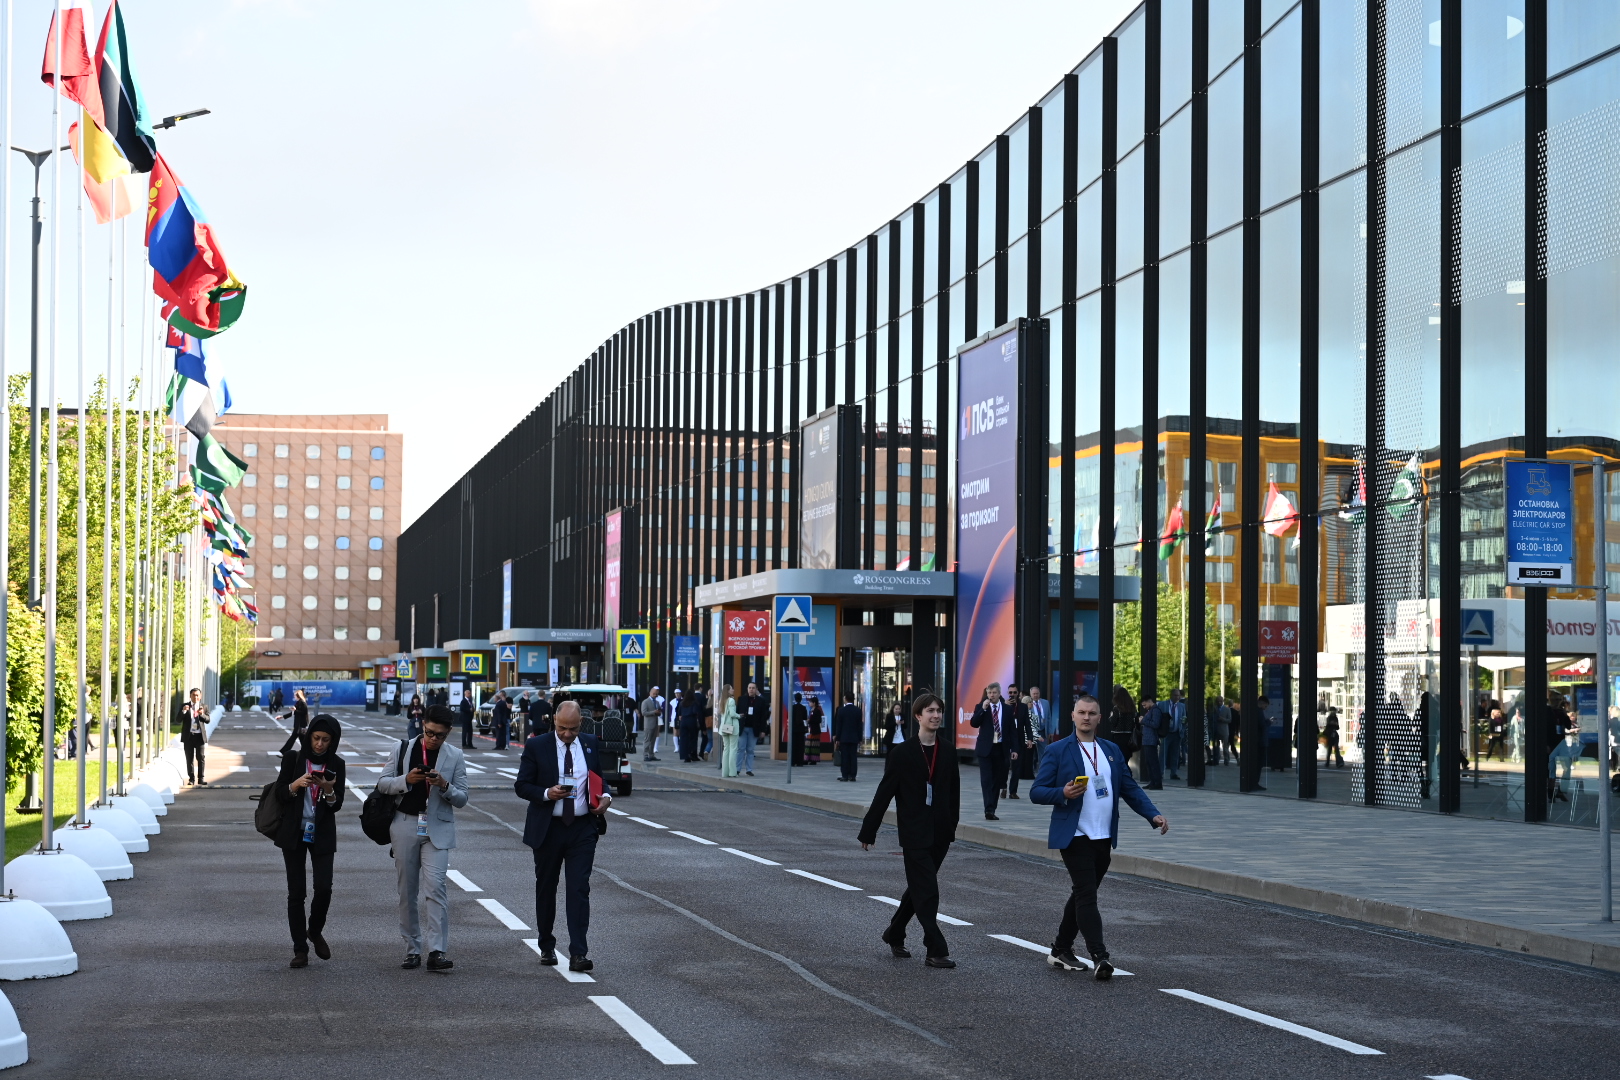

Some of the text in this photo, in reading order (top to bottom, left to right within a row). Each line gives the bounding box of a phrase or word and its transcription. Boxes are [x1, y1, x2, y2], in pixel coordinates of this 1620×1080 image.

[971, 397, 995, 436] ПСБ
[961, 477, 990, 499] смотрим
[1518, 499, 1560, 509] ОСТАНОВКА
[960, 505, 999, 531] за горизонт
[1512, 509, 1566, 520] ЭЛЕКТРОКАРОВ
[1512, 520, 1539, 528] ELECTRIC
[1539, 521, 1551, 529] CAR
[865, 575, 931, 585] ROSCONGRESS
[527, 652, 539, 667] F
[433, 663, 441, 675] E
